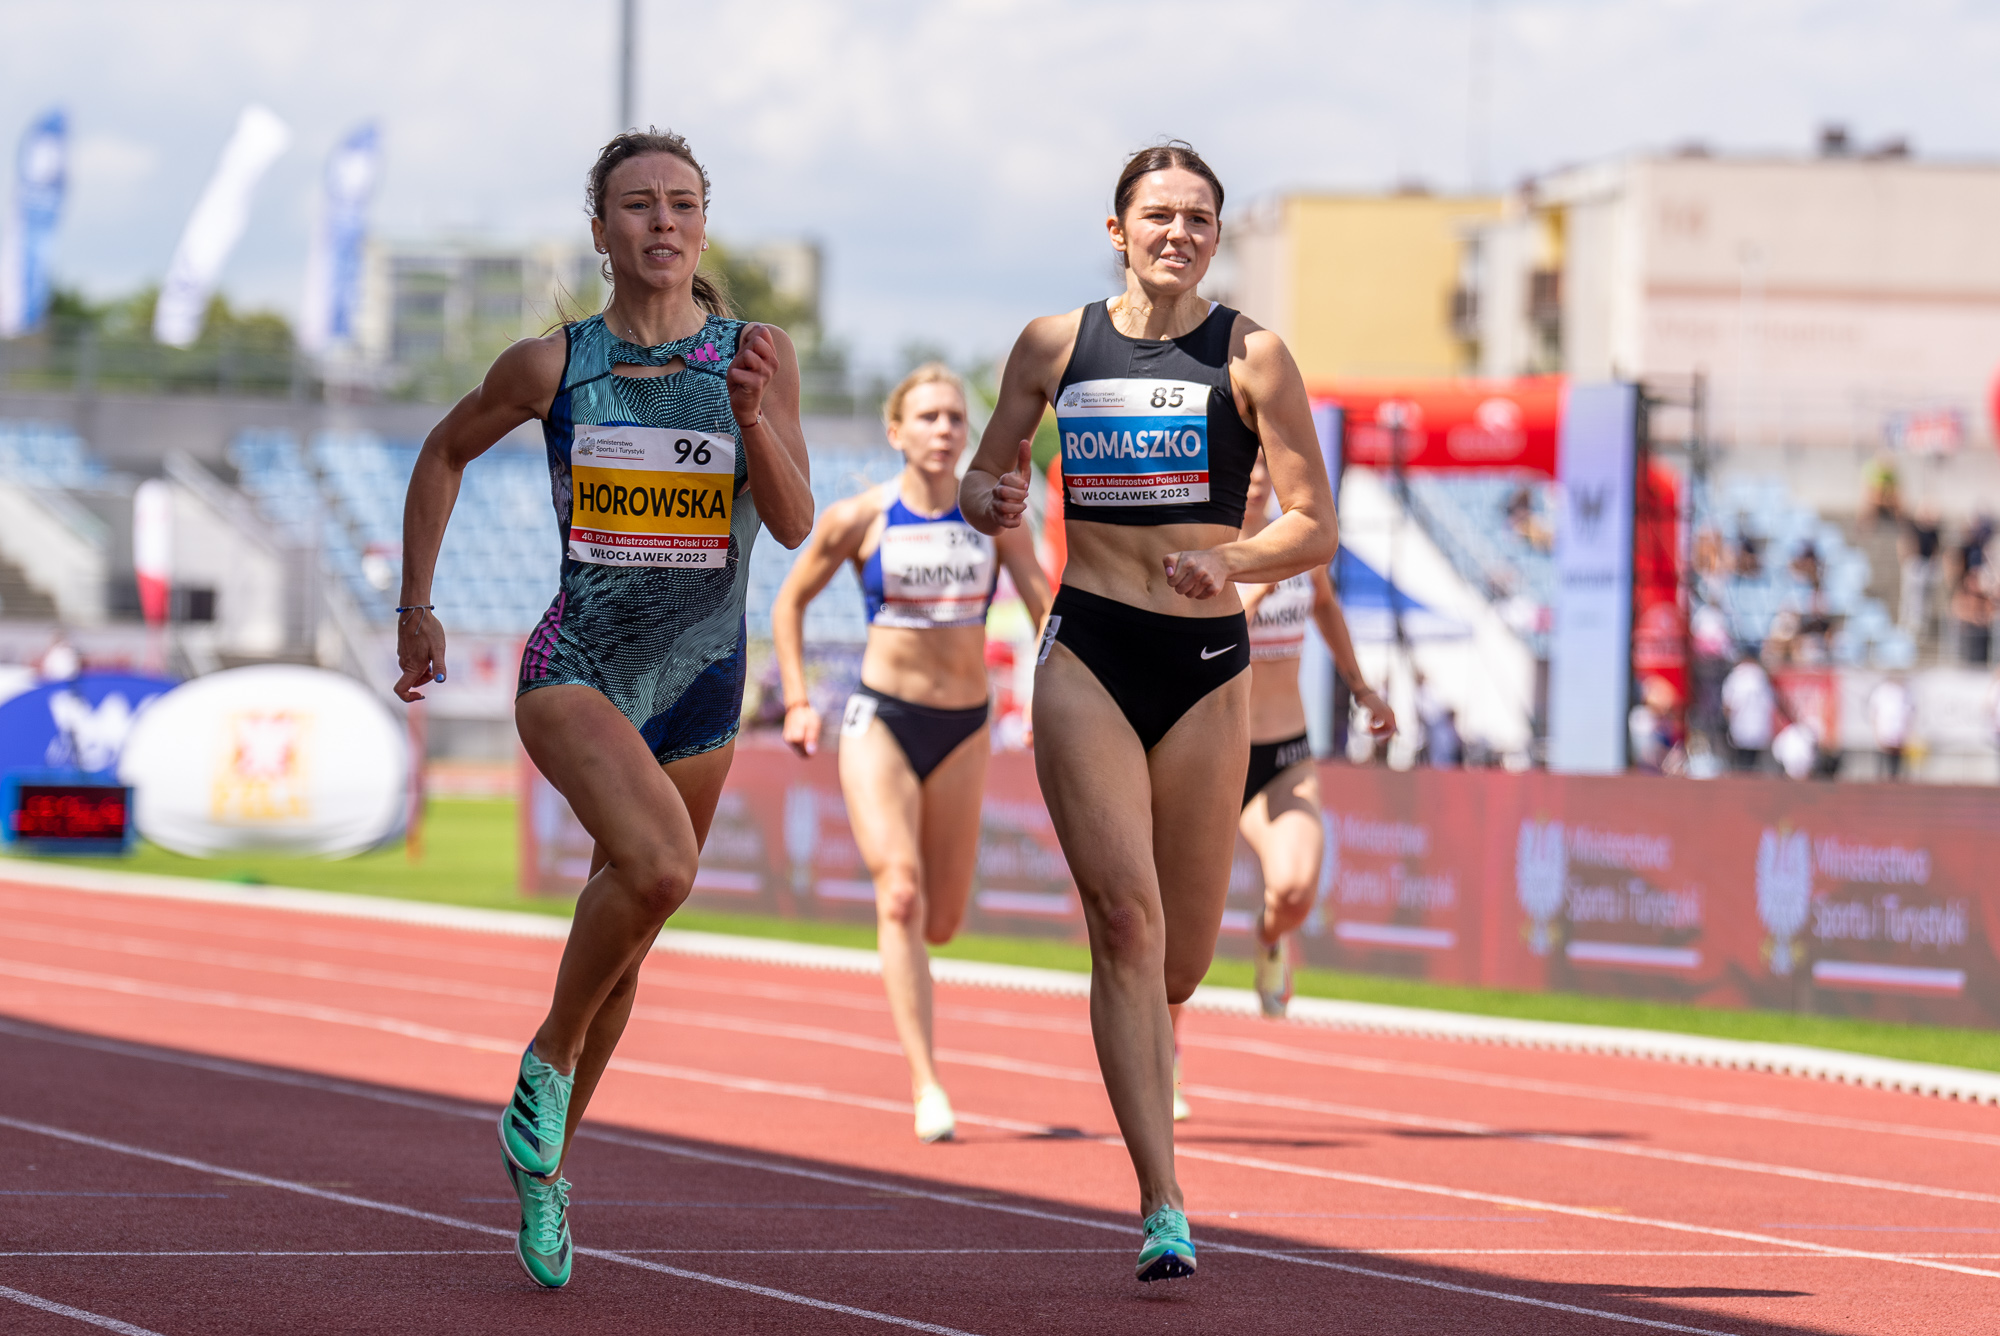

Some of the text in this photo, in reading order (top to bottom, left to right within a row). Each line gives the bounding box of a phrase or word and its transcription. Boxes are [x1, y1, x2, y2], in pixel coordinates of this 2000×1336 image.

[1081, 396, 1098, 404] Sportu
[1102, 396, 1126, 404] Turystyki
[1150, 387, 1185, 408] 85
[596, 438, 633, 447] Ministerstwo
[596, 445, 615, 454] Sportu
[619, 446, 645, 455] Turystyki
[1065, 429, 1201, 460] ROMASZKO
[674, 438, 712, 466] 96
[1072, 474, 1200, 487] 40. PZLA Mistrzostwa Polski U23
[578, 481, 726, 519] HOROWSKA
[1081, 487, 1190, 501] WŁOCŁAWEK 2023
[581, 532, 719, 548] 40. PZLA Mistrzostwa Polski U23
[590, 547, 708, 563] WŁOCŁAWEK 2023
